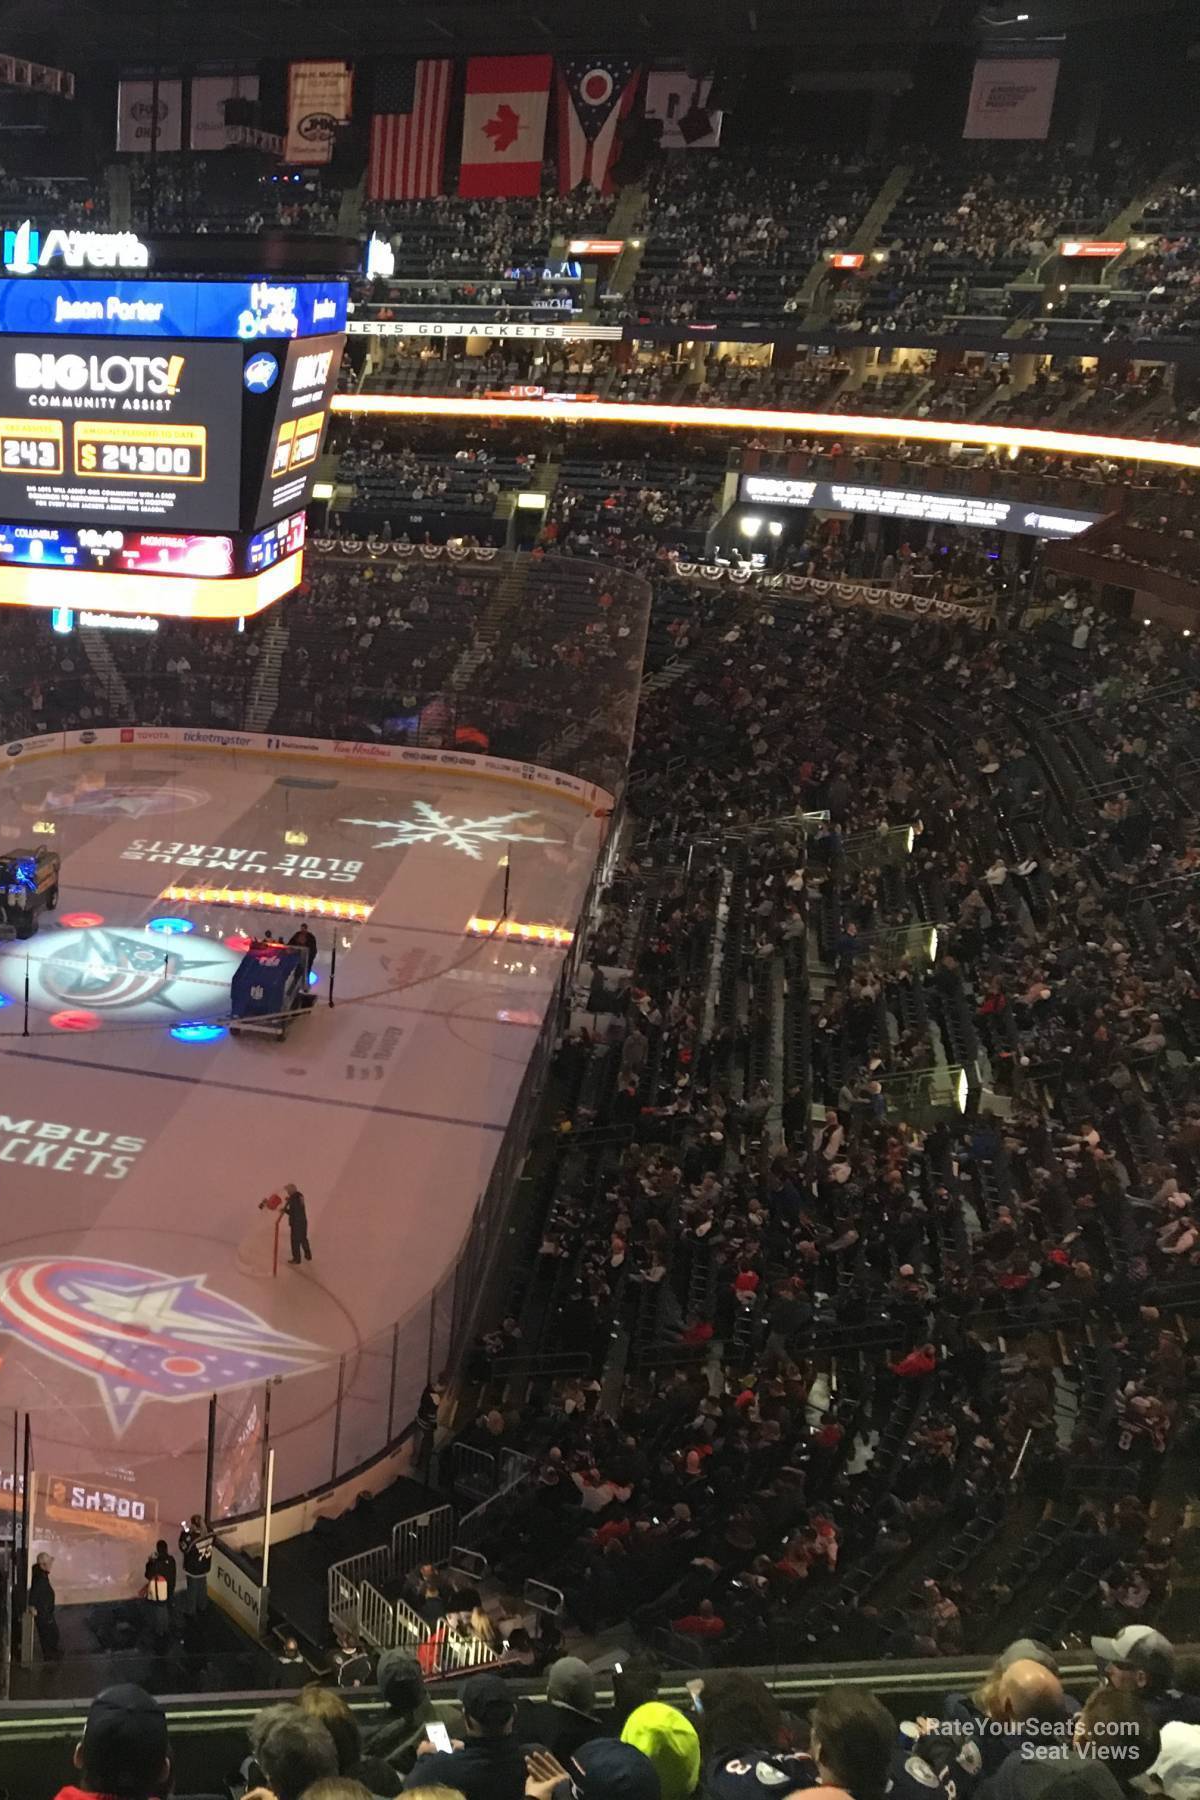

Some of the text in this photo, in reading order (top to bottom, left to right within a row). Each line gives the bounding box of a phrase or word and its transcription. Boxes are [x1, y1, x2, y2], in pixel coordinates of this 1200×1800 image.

[135, 126, 161, 138] OHO
[39, 230, 148, 266] Arena
[107, 296, 163, 320] Porter
[419, 325, 443, 334] GO
[455, 325, 554, 337] JACKETS
[28, 394, 171, 411] COMMUNITY ASSIST
[3, 440, 55, 467] 243
[81, 443, 191, 473] $ 24300
[15, 528, 59, 540] COLUMBUS
[141, 536, 188, 548] MONTREAL
[137, 732, 170, 740] TOYOTA
[183, 732, 252, 746] ticketmaster
[128, 839, 268, 863] JACKETS
[120, 851, 357, 882] COLUMBUS
[279, 854, 364, 873] BLUE
